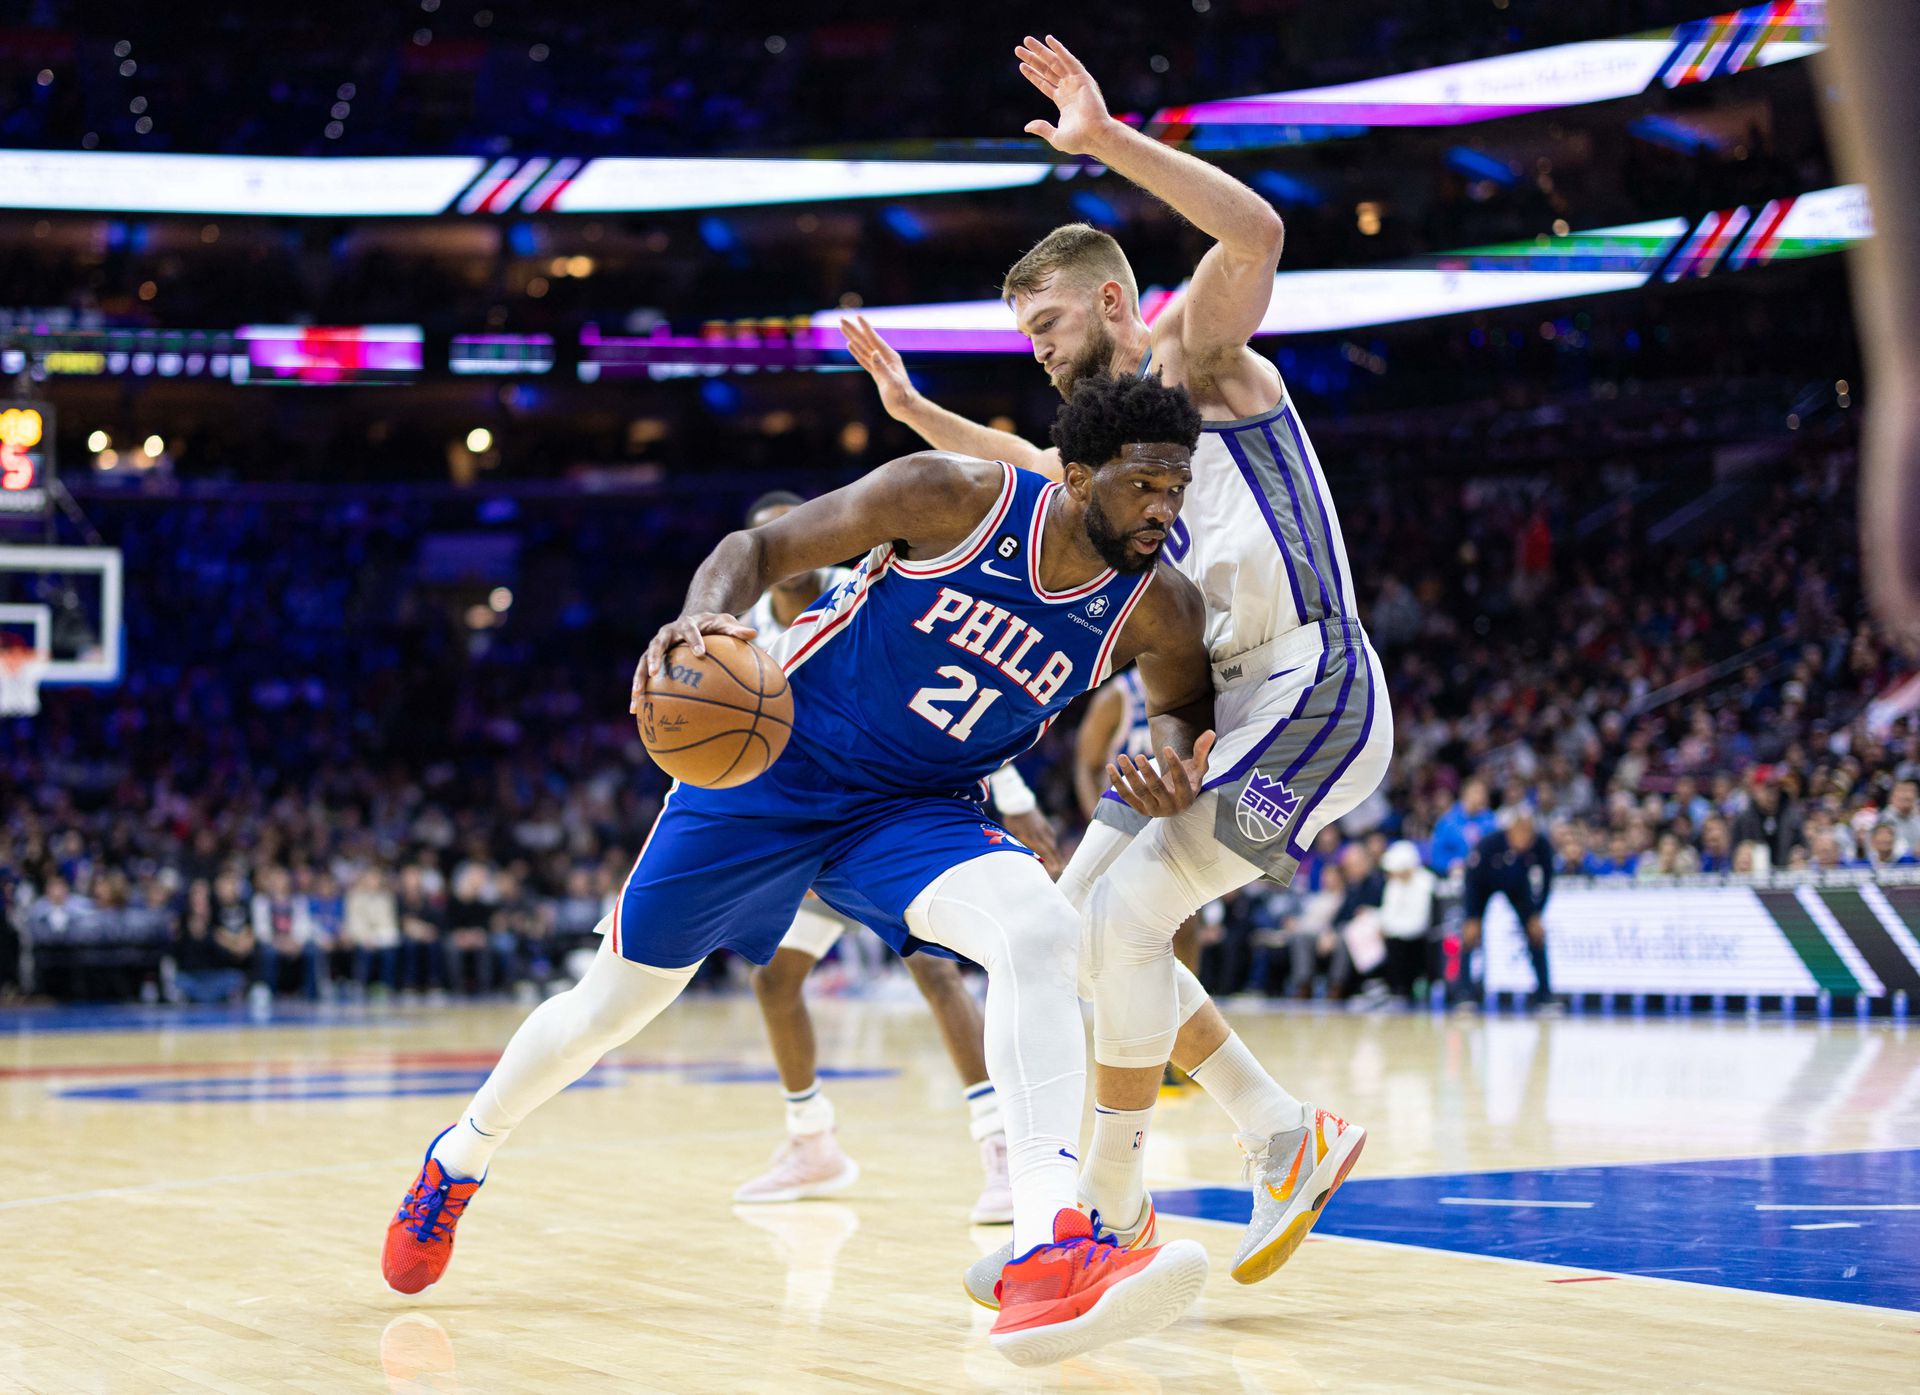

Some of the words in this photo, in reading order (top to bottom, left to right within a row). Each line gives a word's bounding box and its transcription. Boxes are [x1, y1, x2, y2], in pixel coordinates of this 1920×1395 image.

[998, 536, 1018, 558] 6
[1067, 612, 1103, 636] crypto.com
[911, 587, 1073, 706] PHILA
[906, 665, 1003, 742] 21
[1241, 788, 1290, 828] SAC
